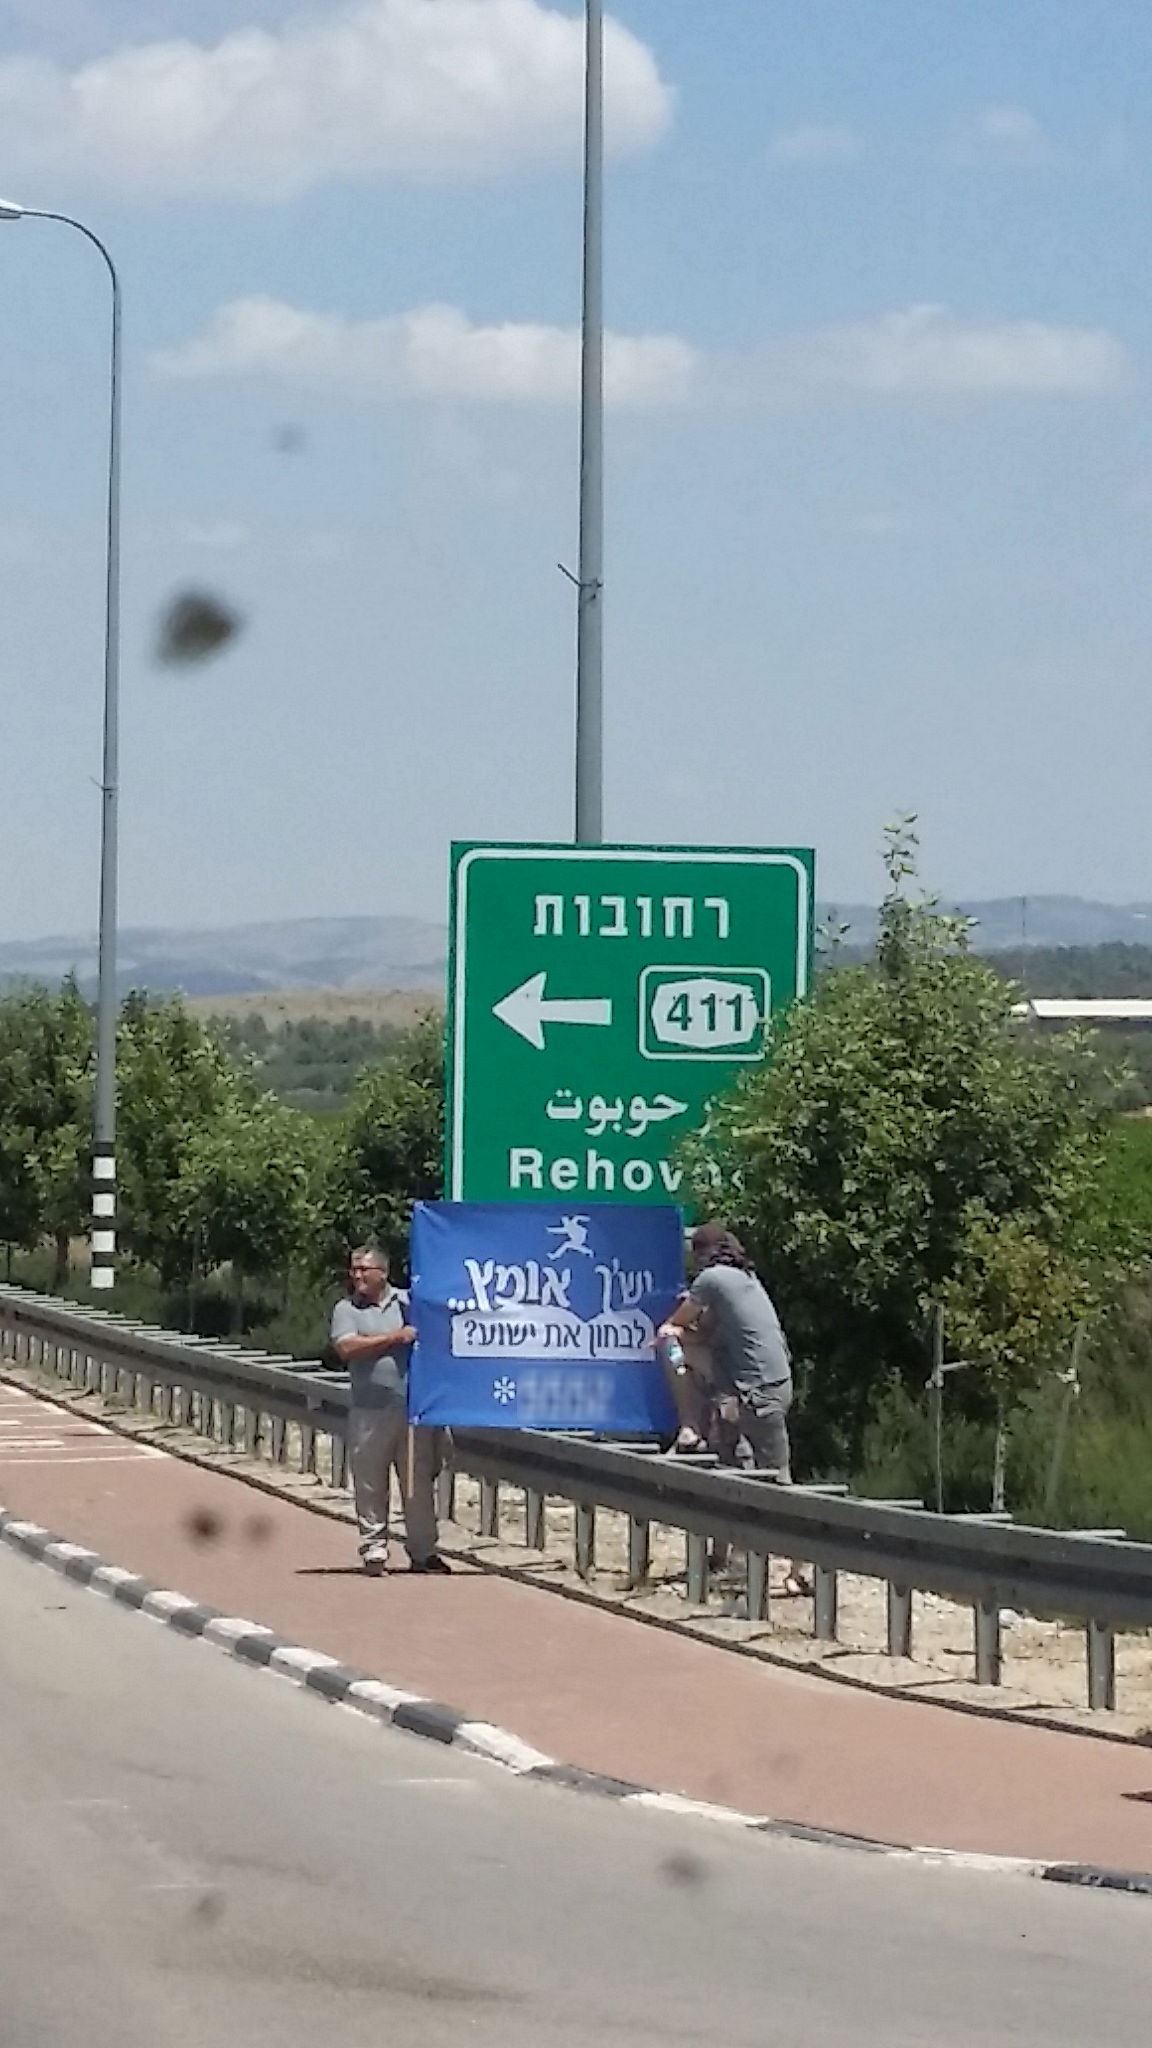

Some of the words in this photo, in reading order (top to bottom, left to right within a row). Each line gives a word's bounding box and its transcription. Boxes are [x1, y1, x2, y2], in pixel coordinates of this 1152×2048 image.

[533, 895, 730, 939] רחובות
[666, 992, 744, 1032] 411
[509, 1147, 745, 1192] Rehov
[464, 1319, 536, 1346] ישוע?
[543, 1324, 581, 1348] את
[588, 1318, 646, 1357] לבחון
